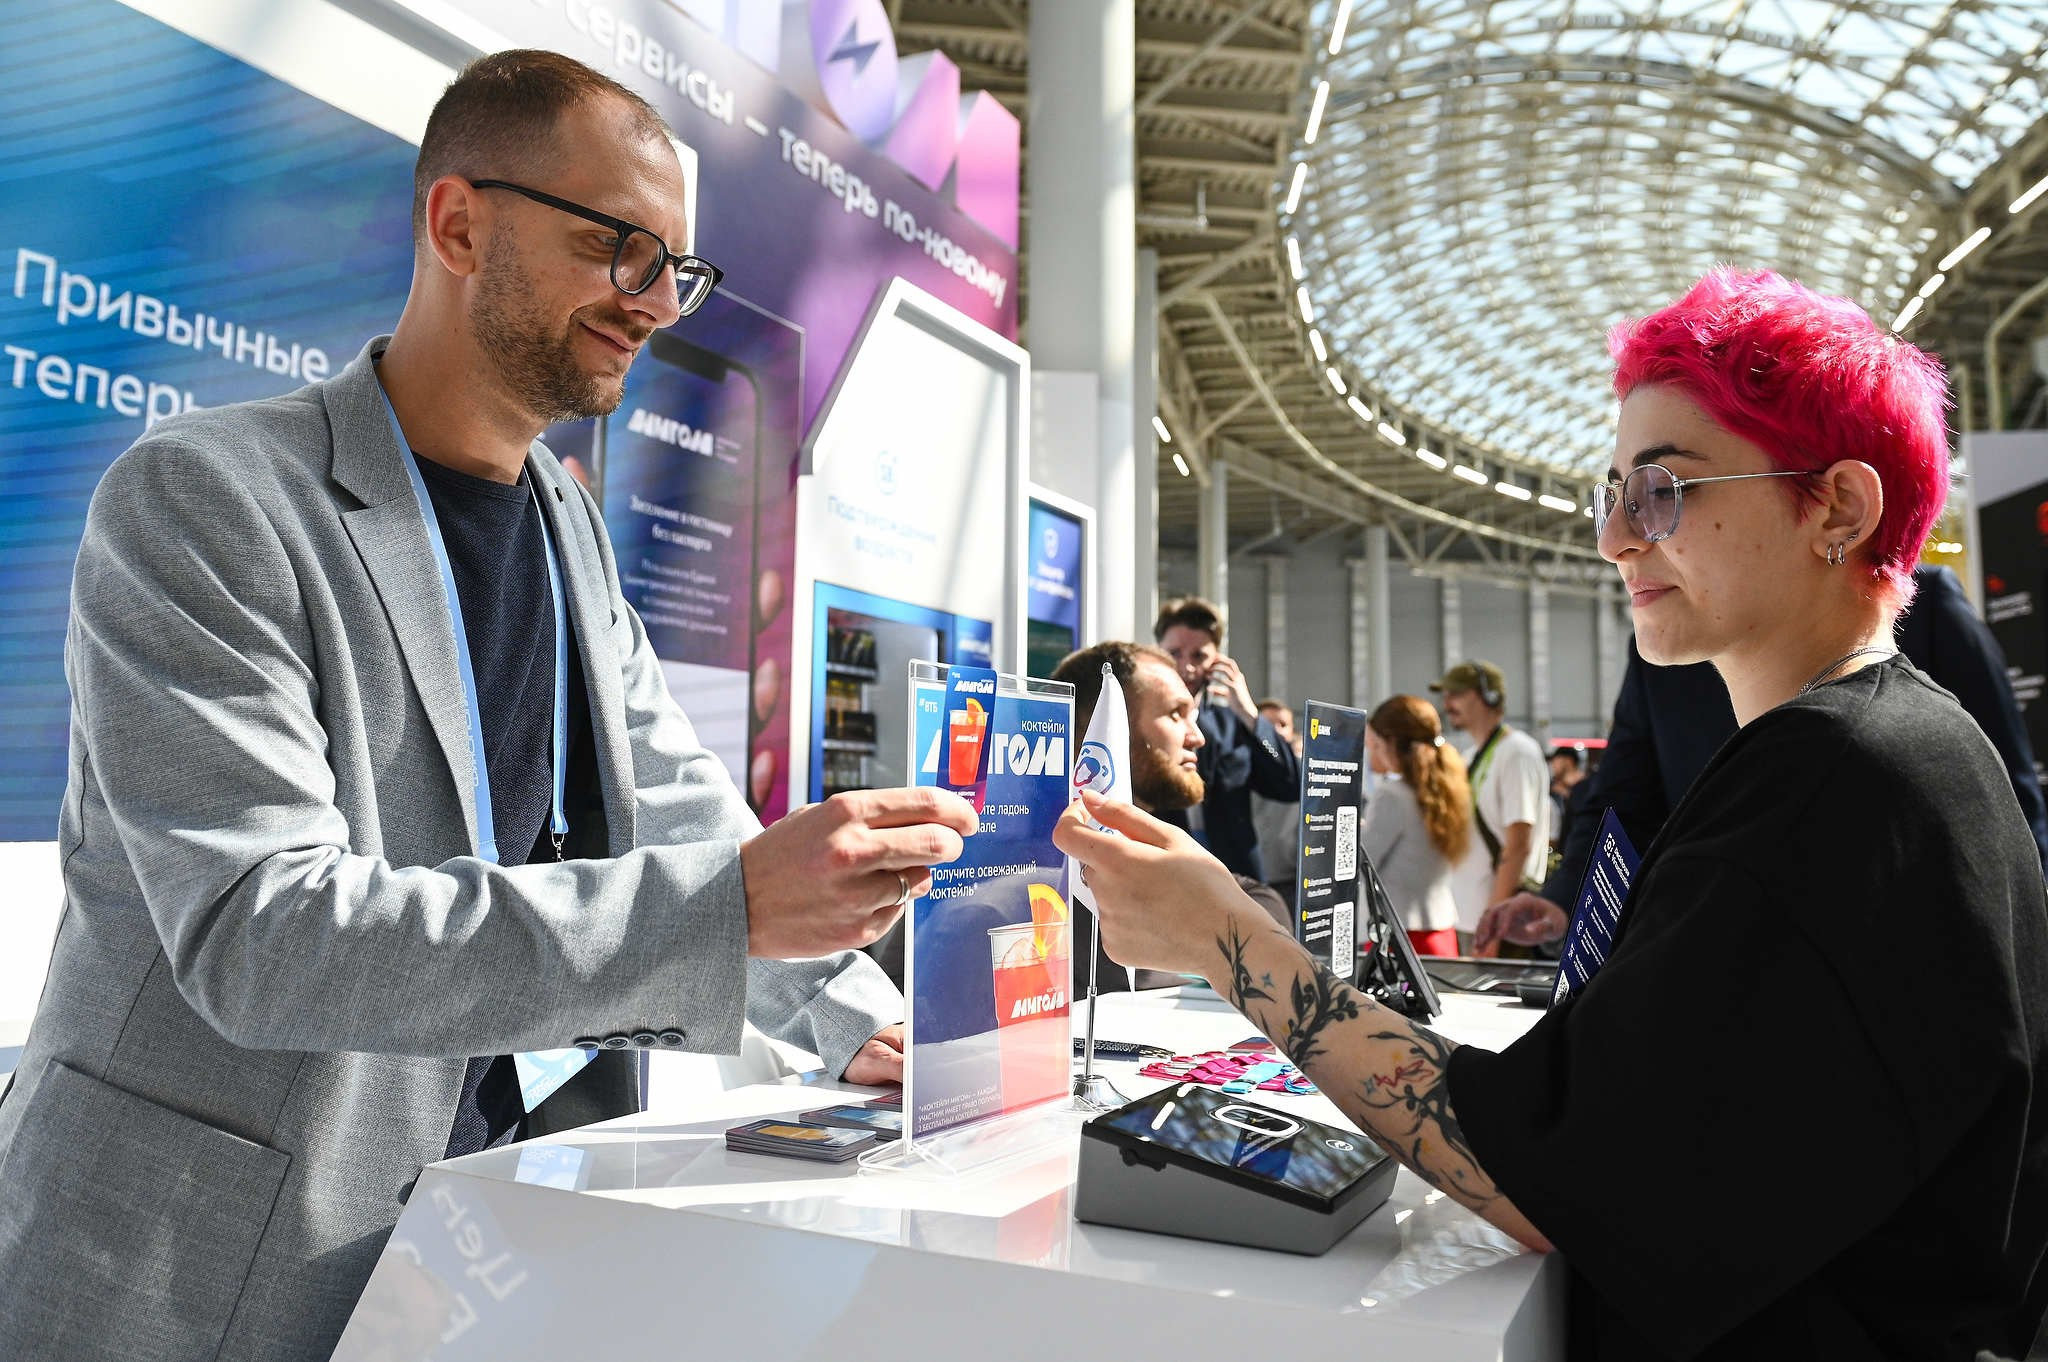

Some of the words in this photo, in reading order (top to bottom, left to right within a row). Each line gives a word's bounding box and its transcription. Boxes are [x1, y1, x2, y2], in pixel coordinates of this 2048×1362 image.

[778, 127, 879, 218] теперь
[884, 199, 1007, 309] по-новому
[14, 247, 330, 383] Привычные
[925, 701, 938, 712] ВТБ
[1021, 719, 1064, 733] коктейли
[998, 804, 1030, 816] ладонь
[930, 867, 975, 883] Получите
[977, 860, 1037, 878] освежающий
[1011, 992, 1064, 1019] МИГОМ
